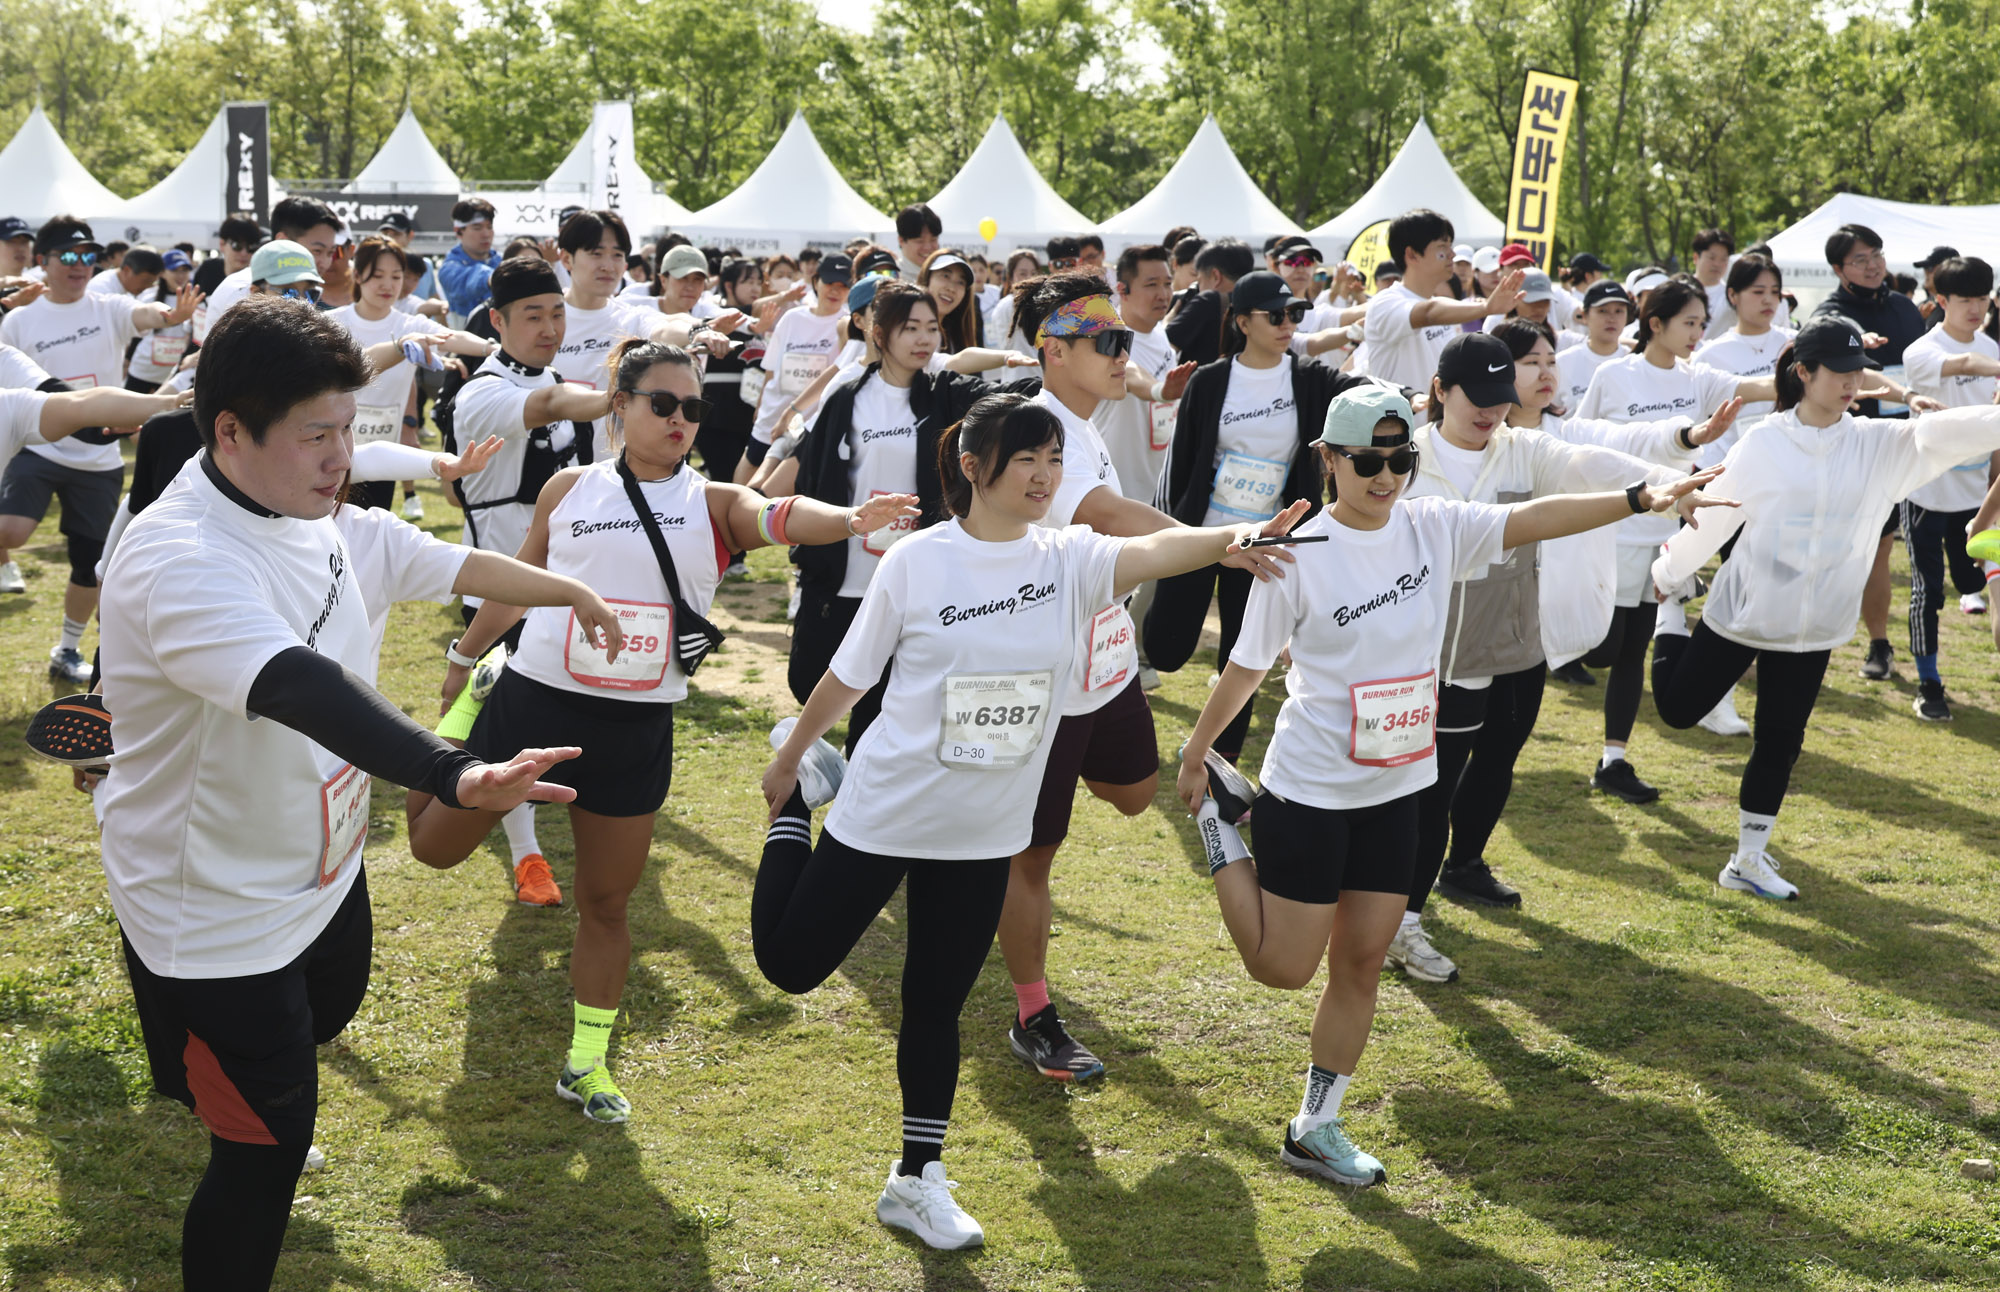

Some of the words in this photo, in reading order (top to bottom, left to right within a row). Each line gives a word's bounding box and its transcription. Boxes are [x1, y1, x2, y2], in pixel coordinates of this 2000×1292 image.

[237, 131, 255, 210] REXY
[606, 135, 620, 210] REXY
[277, 256, 312, 269] HOKA
[34, 334, 78, 353] Burning
[77, 325, 101, 341] Run
[583, 338, 611, 350] Run
[1223, 408, 1272, 425] Burning
[1627, 403, 1673, 417] Burning
[358, 424, 393, 435] 6133
[862, 426, 912, 443] Burning
[1224, 475, 1234, 485] W
[1235, 478, 1276, 496] 8135
[571, 519, 642, 538] Burning
[938, 597, 1018, 627] Burning
[1017, 582, 1057, 606] Run
[1333, 589, 1399, 627] Burning
[1395, 565, 1430, 595] Run
[619, 609, 638, 618] RUN
[953, 681, 996, 690] BURNING
[997, 680, 1017, 688] RUN
[1361, 688, 1399, 700] BURNING
[1399, 686, 1415, 695] RUN
[956, 711, 972, 724] W
[974, 705, 1041, 726] 6387
[1365, 718, 1380, 730] W
[1382, 705, 1431, 732] 3456
[953, 746, 985, 758] D-30
[1205, 817, 1223, 858] GOWON
[578, 1019, 613, 1028] HIGHLIG
[1304, 1079, 1321, 1115] GOWON
